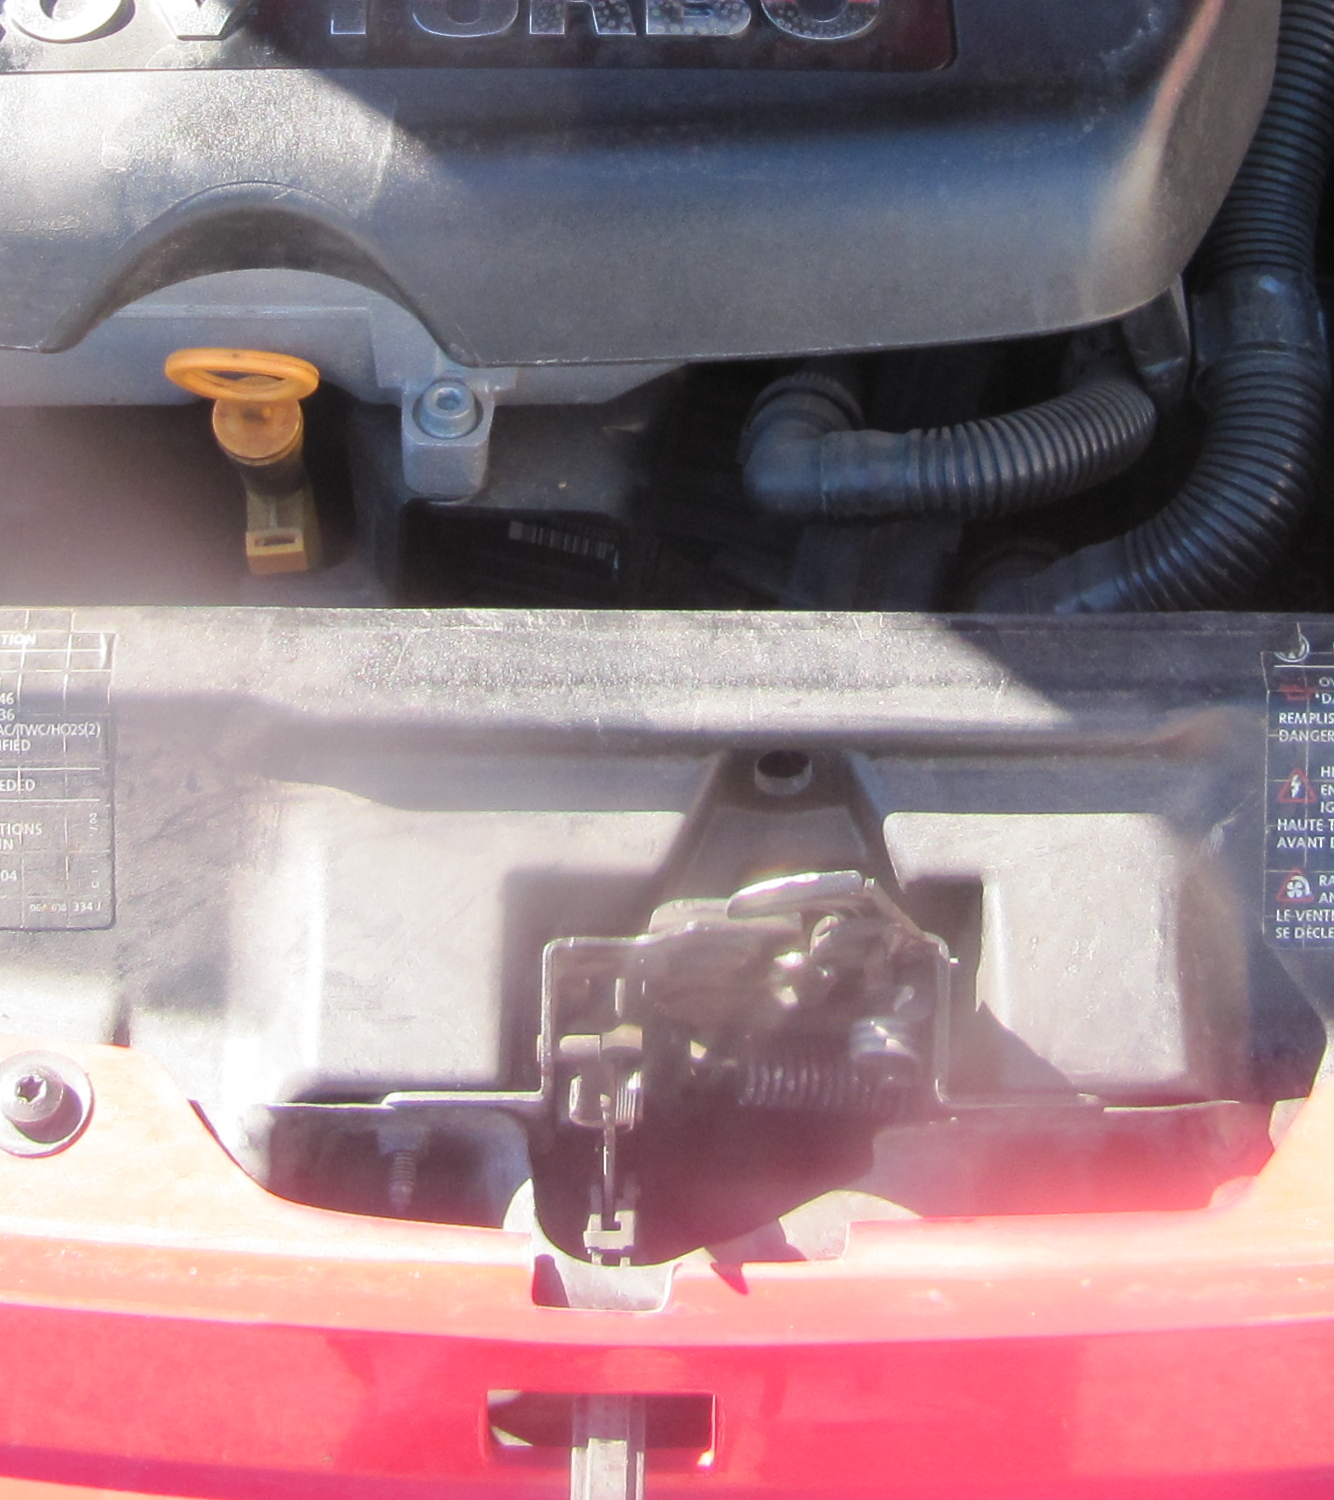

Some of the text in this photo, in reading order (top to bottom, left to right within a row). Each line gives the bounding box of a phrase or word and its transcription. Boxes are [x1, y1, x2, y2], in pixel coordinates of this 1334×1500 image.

[1277, 819, 1324, 832] HAUTE
[1277, 837, 1325, 849] AVANT
[1276, 909, 1291, 921] LE
[1275, 927, 1290, 938] SE
